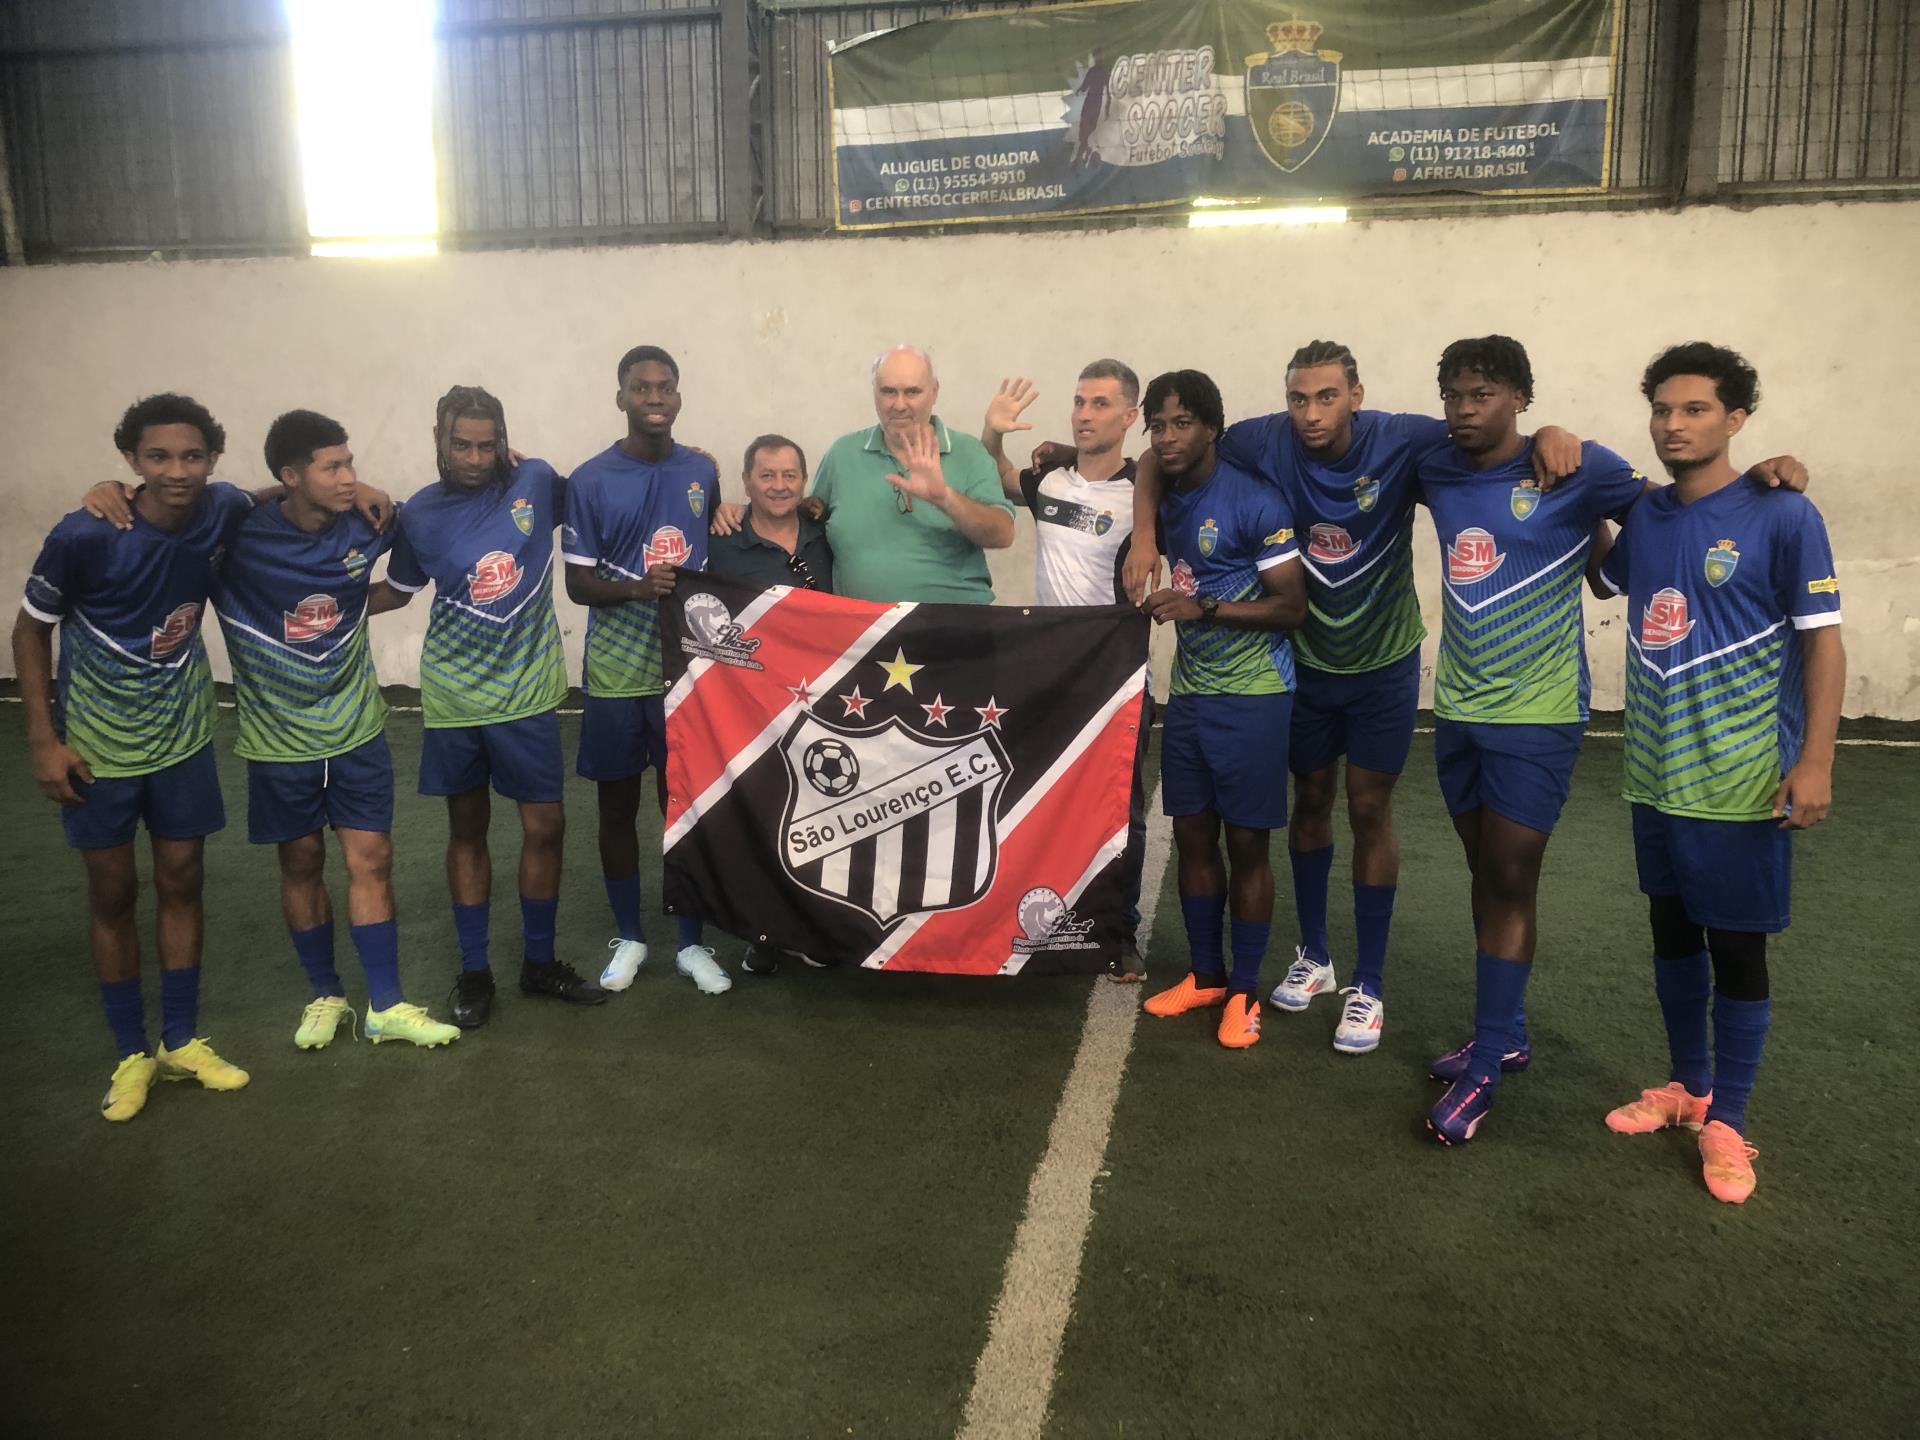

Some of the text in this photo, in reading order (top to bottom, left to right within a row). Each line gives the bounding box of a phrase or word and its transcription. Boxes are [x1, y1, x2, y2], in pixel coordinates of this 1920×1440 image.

[1110, 46, 1215, 99] CENTER
[1262, 67, 1325, 83] Real Brasil
[1123, 94, 1227, 144] SOCCER
[1368, 122, 1560, 145] ACADEMIA DE FUTEBOL
[880, 150, 1040, 175] ALUGUEL DE QUADRA
[1129, 141, 1176, 162] Futebol
[1409, 145, 1440, 164] (11)
[912, 170, 1026, 193] (11) 95554-9910
[1413, 161, 1529, 180] AFREALBRASIL
[865, 184, 1067, 211] CENTERSOCCERREALBRASIL
[655, 537, 685, 556] SM
[1312, 531, 1348, 550] SM
[1457, 541, 1494, 562] SM
[479, 560, 514, 583] SM
[300, 604, 337, 623] SM
[1653, 602, 1686, 627] SM
[789, 753, 997, 854] São Lourenço E.C.
